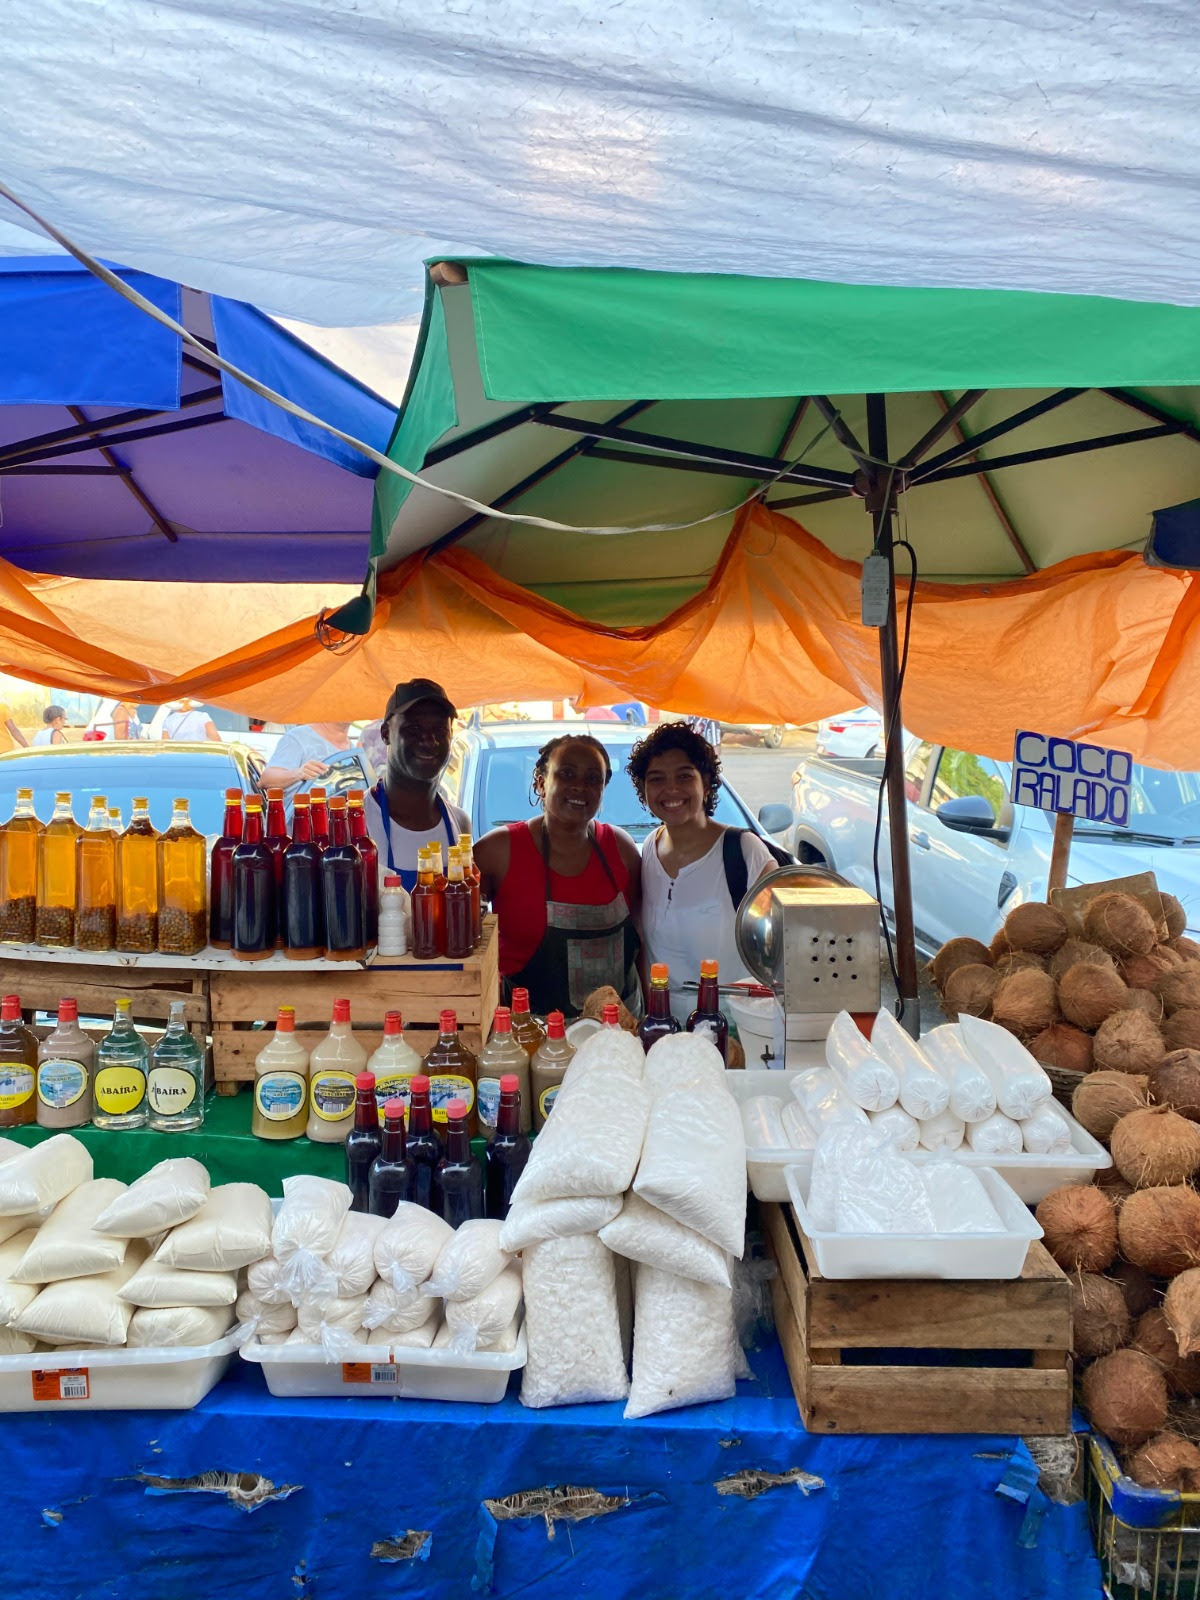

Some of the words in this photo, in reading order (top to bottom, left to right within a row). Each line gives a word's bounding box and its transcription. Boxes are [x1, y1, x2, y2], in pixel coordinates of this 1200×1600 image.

[1016, 731, 1133, 785] COCO
[1015, 768, 1128, 825] RALADO
[100, 1086, 138, 1095] ABAÍRA
